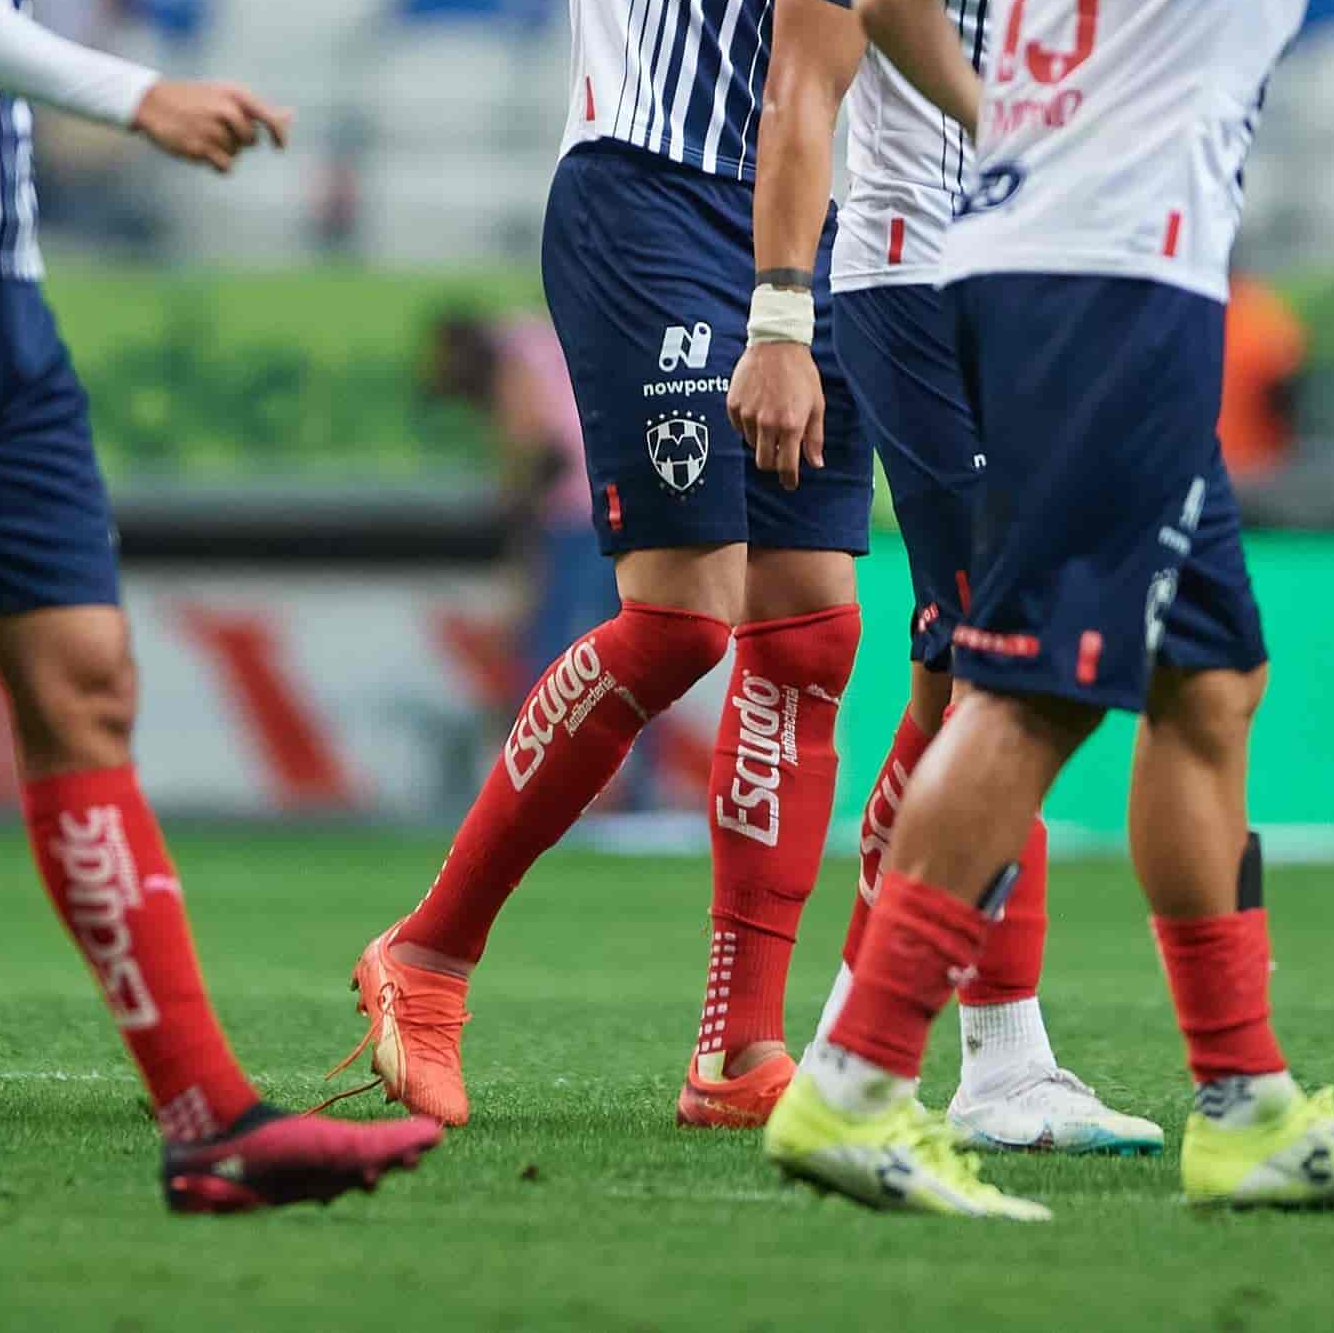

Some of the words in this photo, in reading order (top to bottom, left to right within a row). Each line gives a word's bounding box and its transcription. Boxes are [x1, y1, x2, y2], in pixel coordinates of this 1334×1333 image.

[643, 375, 729, 397] nowports
[504, 638, 601, 793] Escudo
[717, 674, 780, 848] Escudo
[780, 685, 800, 766] Antibacterial
